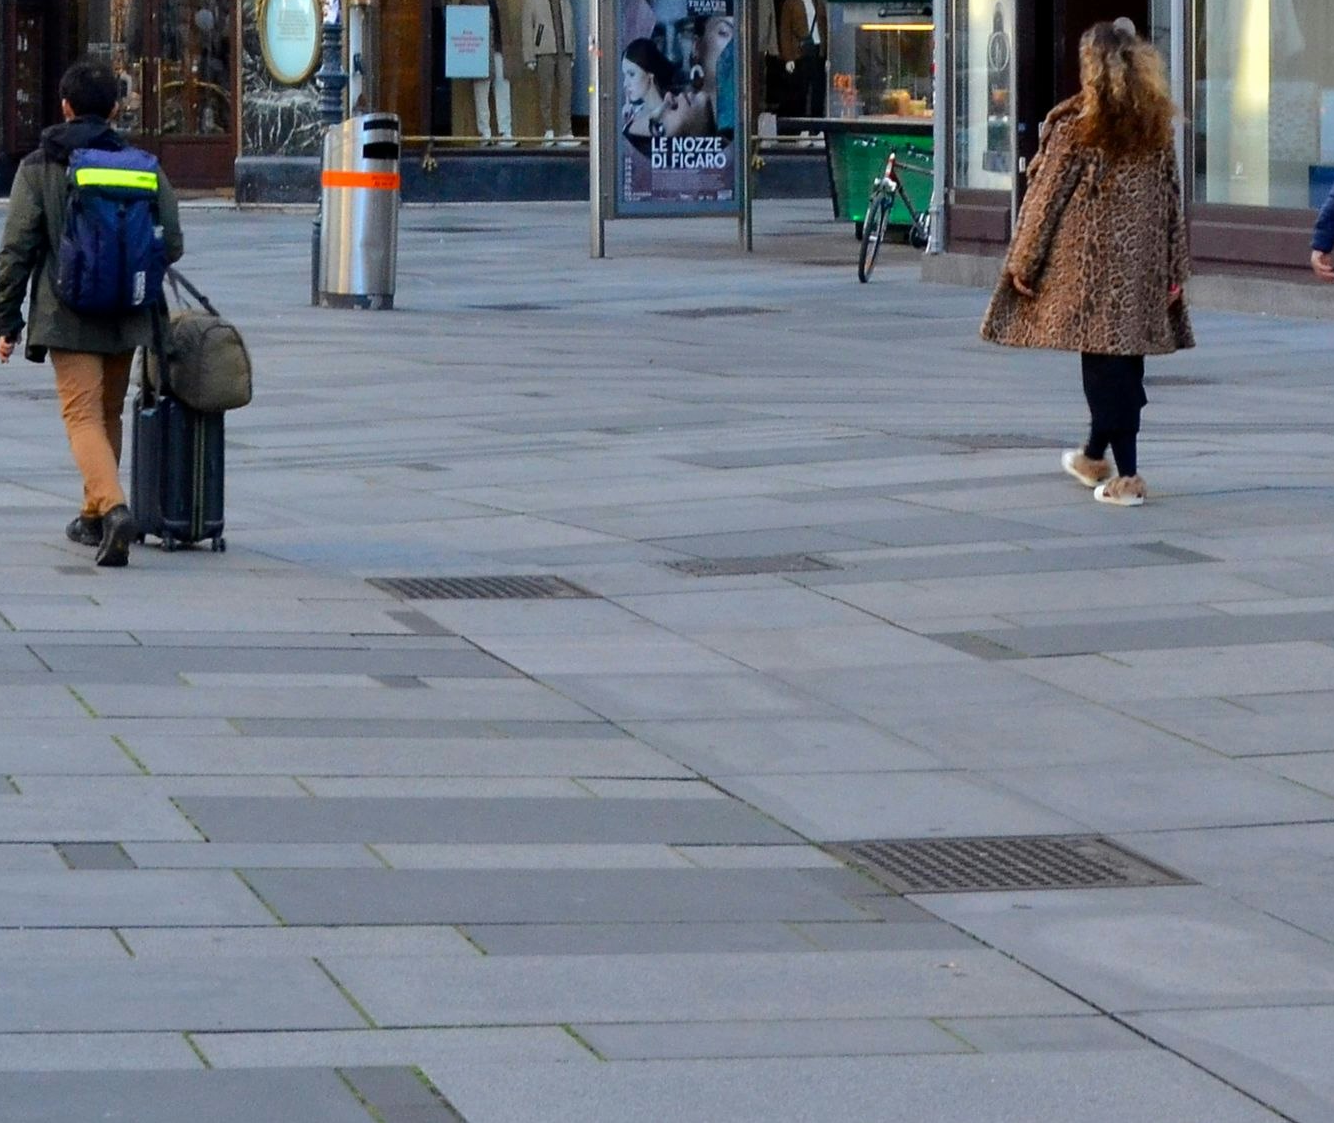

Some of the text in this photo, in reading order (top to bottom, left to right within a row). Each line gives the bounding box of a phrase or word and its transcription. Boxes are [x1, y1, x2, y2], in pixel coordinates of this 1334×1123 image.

[652, 137, 722, 152] LE NOZZE
[651, 153, 727, 169] DI FIGARO
